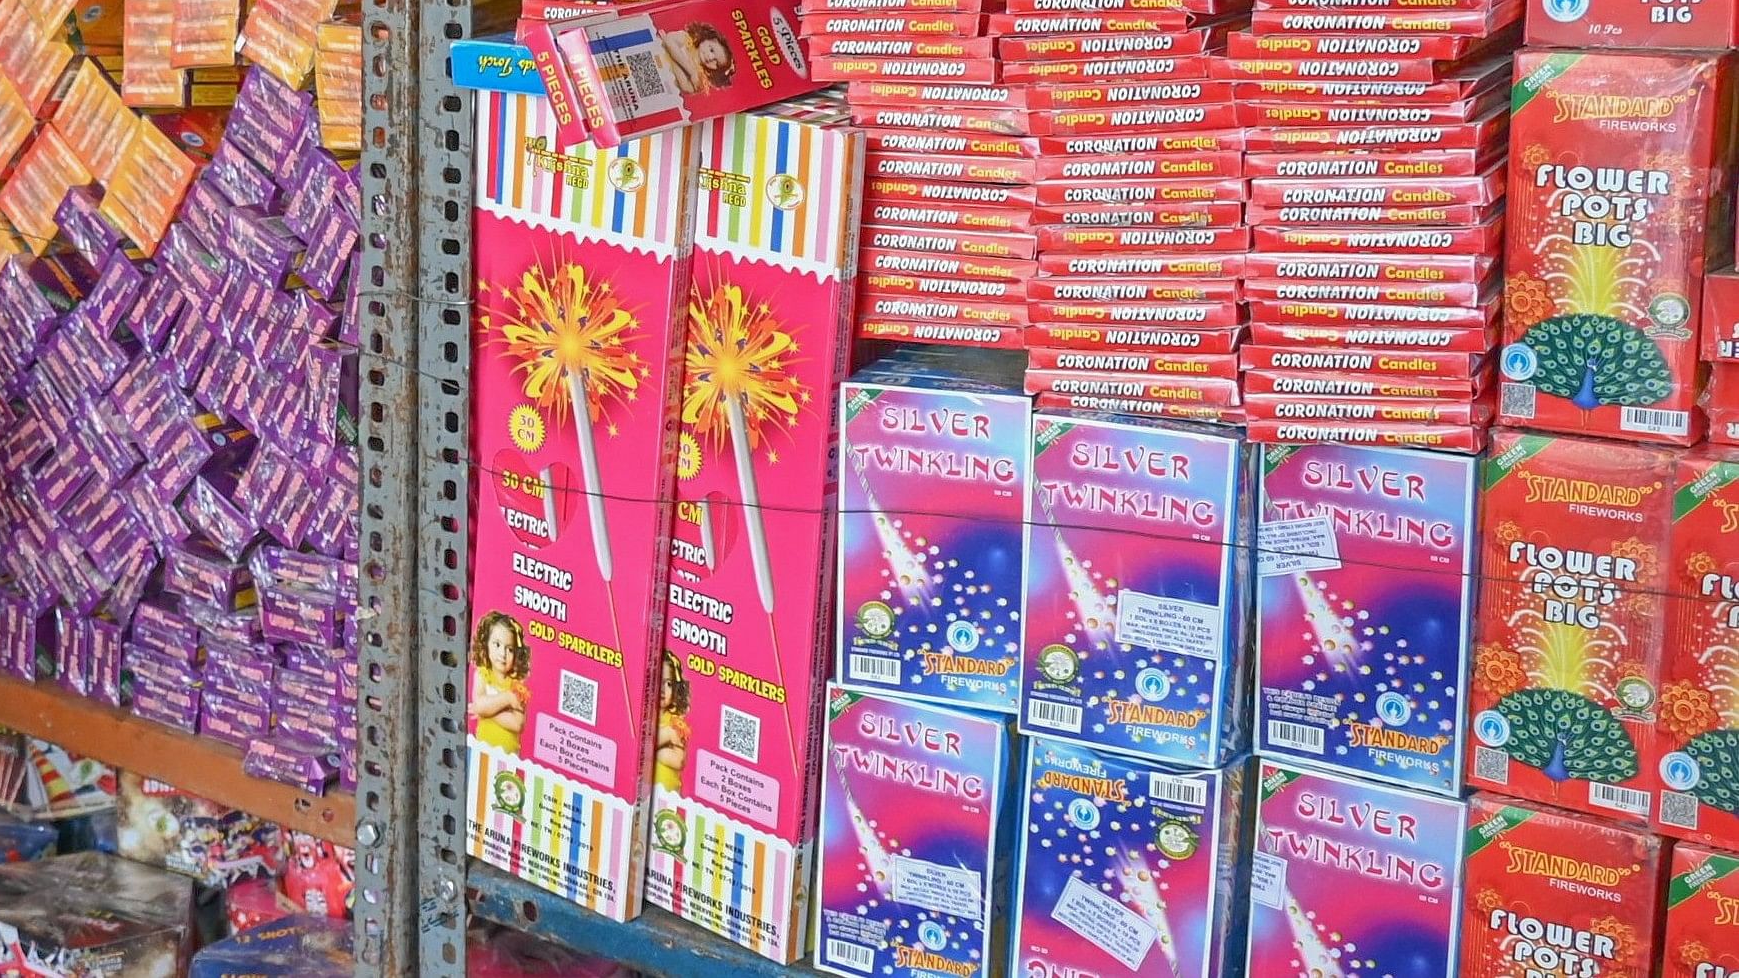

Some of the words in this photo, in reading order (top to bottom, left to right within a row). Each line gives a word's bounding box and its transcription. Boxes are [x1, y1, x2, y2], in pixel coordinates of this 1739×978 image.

[1650, 4, 1693, 23] BIG
[731, 10, 773, 91] SPARKLES
[755, 25, 781, 66] GOLD
[778, 26, 804, 71] Pieces
[544, 63, 573, 127] PIECES
[575, 65, 605, 129] PIECES
[622, 76, 640, 112] ARUNA
[1598, 120, 1677, 134] FIREWORKS
[1535, 164, 1670, 196] FLOWER
[874, 206, 959, 224] CORONATION
[964, 212, 1012, 229] Candles
[1561, 193, 1648, 223] POTS
[1572, 221, 1633, 248] BIG
[1276, 262, 1379, 280] CORONATION
[1384, 264, 1445, 282] Candles
[1048, 328, 1100, 345] Candles
[1106, 331, 1201, 347] CORONATION
[1271, 353, 1372, 372] CORONATION
[1378, 356, 1438, 373] Candles
[517, 428, 536, 443] CM
[519, 414, 535, 429] 30
[881, 405, 991, 440] SILVER
[855, 445, 1015, 483] TWINKLING
[1072, 440, 1191, 481] SILVER
[501, 470, 520, 490] 30
[522, 476, 547, 499] CM
[1303, 460, 1427, 502] SILVER
[1042, 481, 1215, 527] TWINKLING
[1568, 503, 1644, 523] FIREWORKS
[512, 551, 573, 591] ELECTRIC
[1508, 540, 1637, 582] FLOWER
[514, 585, 568, 623] SMOOTH
[669, 583, 733, 624] ELECTRIC
[1531, 573, 1622, 606] POTS
[1543, 601, 1600, 629] BIG
[528, 620, 557, 648] GOLD
[558, 631, 624, 670] SPARKLERS
[671, 619, 728, 656] SMOOTH
[686, 654, 716, 678] GOLD
[718, 665, 787, 705] SPARKLERS
[940, 674, 1008, 693] FIREWORKS
[861, 712, 962, 755] SILVER
[1125, 724, 1196, 746] FIREWORKS
[711, 759, 728, 773] Pack
[730, 767, 765, 789] Contains
[838, 745, 983, 802] TWINKLING
[1368, 748, 1440, 773] FIREWORKS
[700, 775, 719, 791] Each
[720, 783, 737, 797] Box
[737, 790, 773, 813] Contains
[727, 777, 752, 795] Boxes
[725, 796, 751, 814] Pieces
[1297, 791, 1417, 842] SILVER
[468, 819, 484, 834] THE
[485, 826, 511, 847] ARUNA
[513, 838, 561, 870] FIREWORKS
[1268, 829, 1443, 890] TWINKLING
[1548, 878, 1623, 903] FIREWORKS
[1489, 908, 1617, 961] FLOWER
